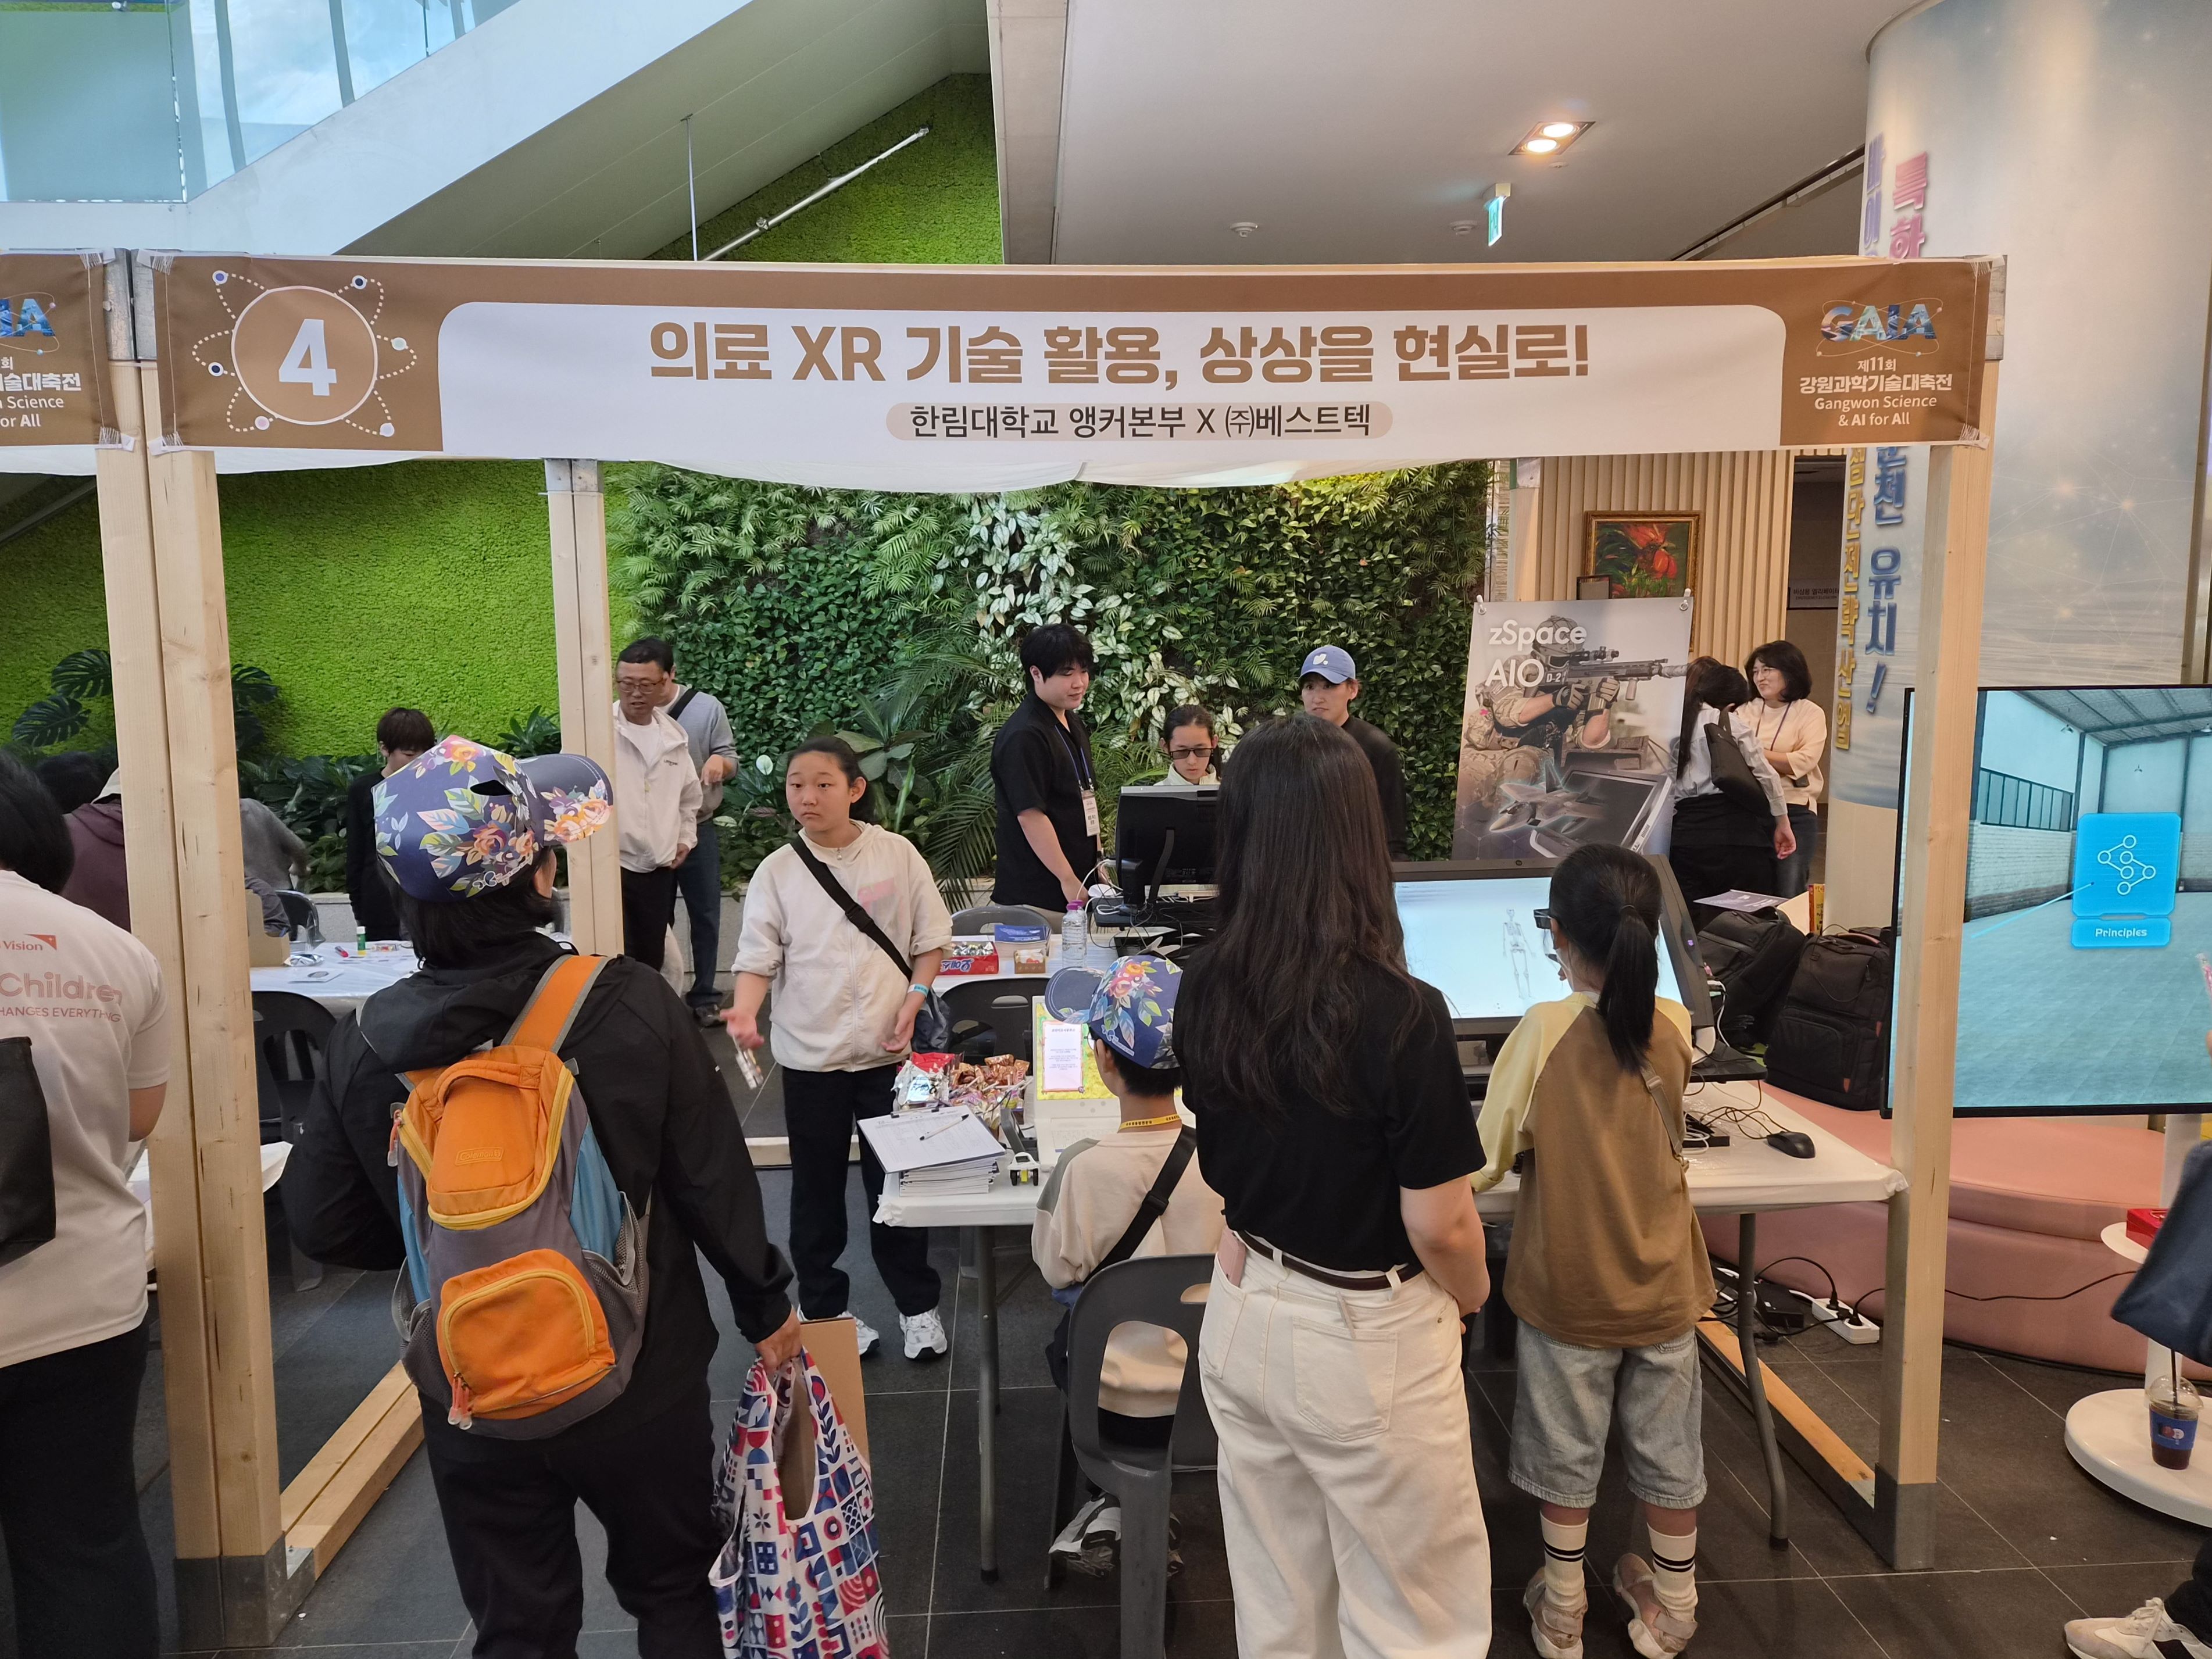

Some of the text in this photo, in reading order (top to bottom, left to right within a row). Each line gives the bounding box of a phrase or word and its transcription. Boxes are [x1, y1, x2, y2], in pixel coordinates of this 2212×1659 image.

[0, 299, 55, 337] IA
[1821, 304, 1937, 341] GAIA
[0, 356, 13, 370] 회
[278, 319, 337, 396] 4
[650, 322, 1589, 391] 의료 XR 기술 활용, 상상을 현실로!
[1857, 356, 1896, 372] 제11회
[0, 373, 81, 391] 술대축전
[1800, 374, 1953, 394] 강원과학기술대축전
[8, 395, 64, 409] Science
[1814, 395, 1937, 412] Gangwon Science
[0, 413, 41, 427] or All
[910, 405, 1059, 438] 한림대학교
[1069, 405, 1185, 438] 앵커본부
[1196, 408, 1216, 434] X
[1838, 412, 1910, 427] & AI for All
[1489, 619, 1587, 650] zSpace
[1485, 658, 1544, 687] AIO
[2095, 928, 2147, 939] Principles
[3, 941, 43, 950] Vision
[0, 1006, 49, 1017] HANGES
[460, 1151, 494, 1161] Coleman
